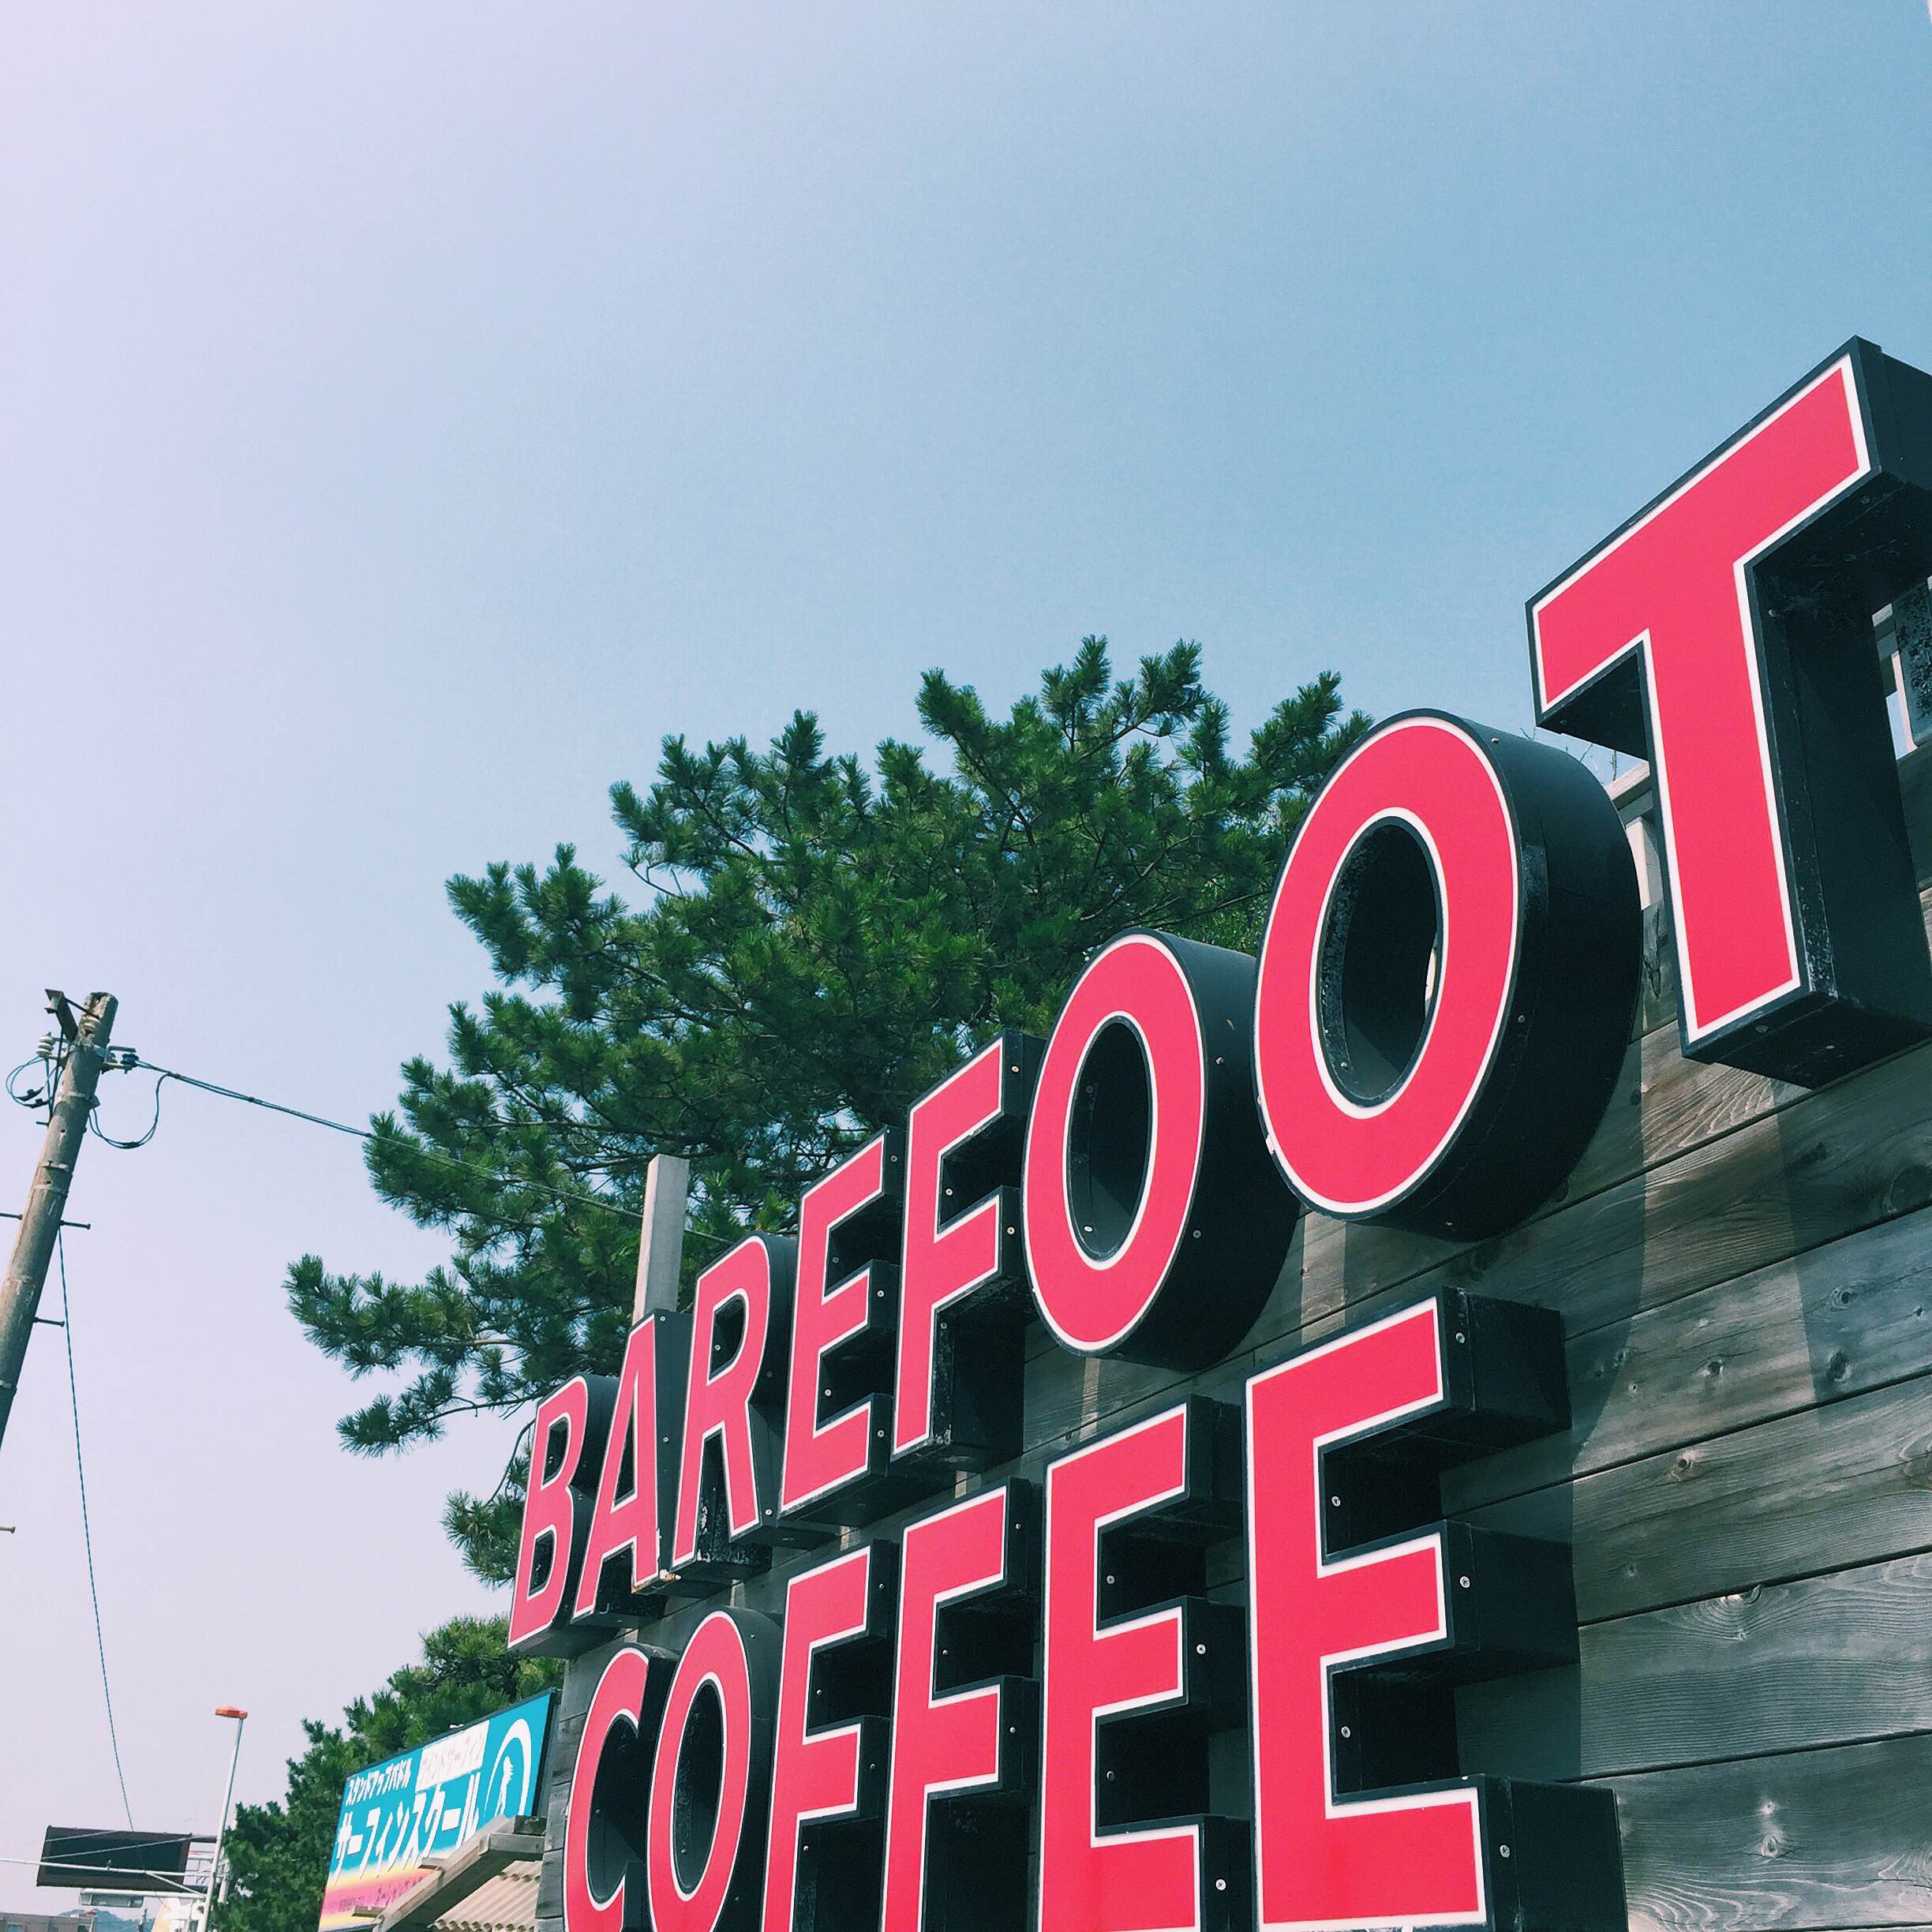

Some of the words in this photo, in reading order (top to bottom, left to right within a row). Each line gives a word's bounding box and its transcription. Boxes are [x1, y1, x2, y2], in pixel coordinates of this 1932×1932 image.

[506, 338, 1878, 1653] BAREFOOT
[334, 1772, 481, 1885] サーフィンスクール
[563, 1293, 1490, 1931] COFFEE
